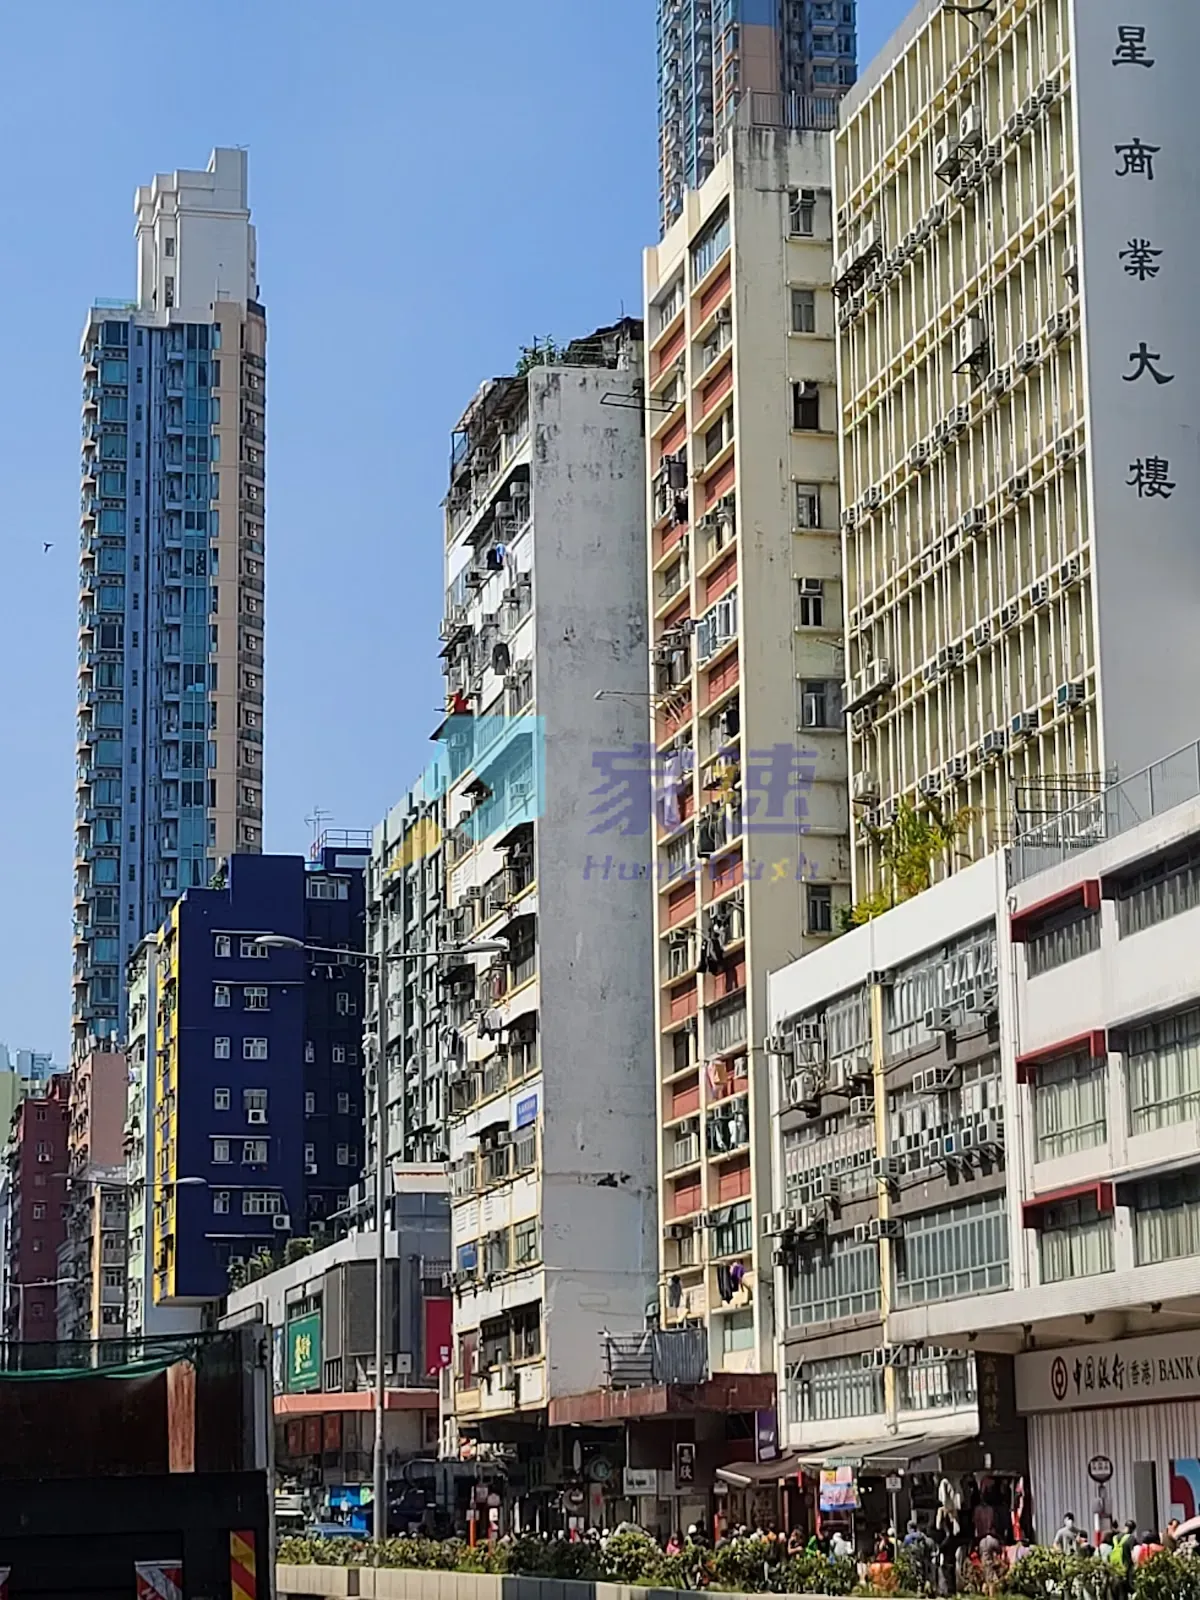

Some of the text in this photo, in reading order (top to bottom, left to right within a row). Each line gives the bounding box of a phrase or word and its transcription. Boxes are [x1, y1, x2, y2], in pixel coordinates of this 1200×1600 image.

[1112, 26, 1176, 498] 星商業大樓
[1158, 1356, 1194, 1381] BANK
